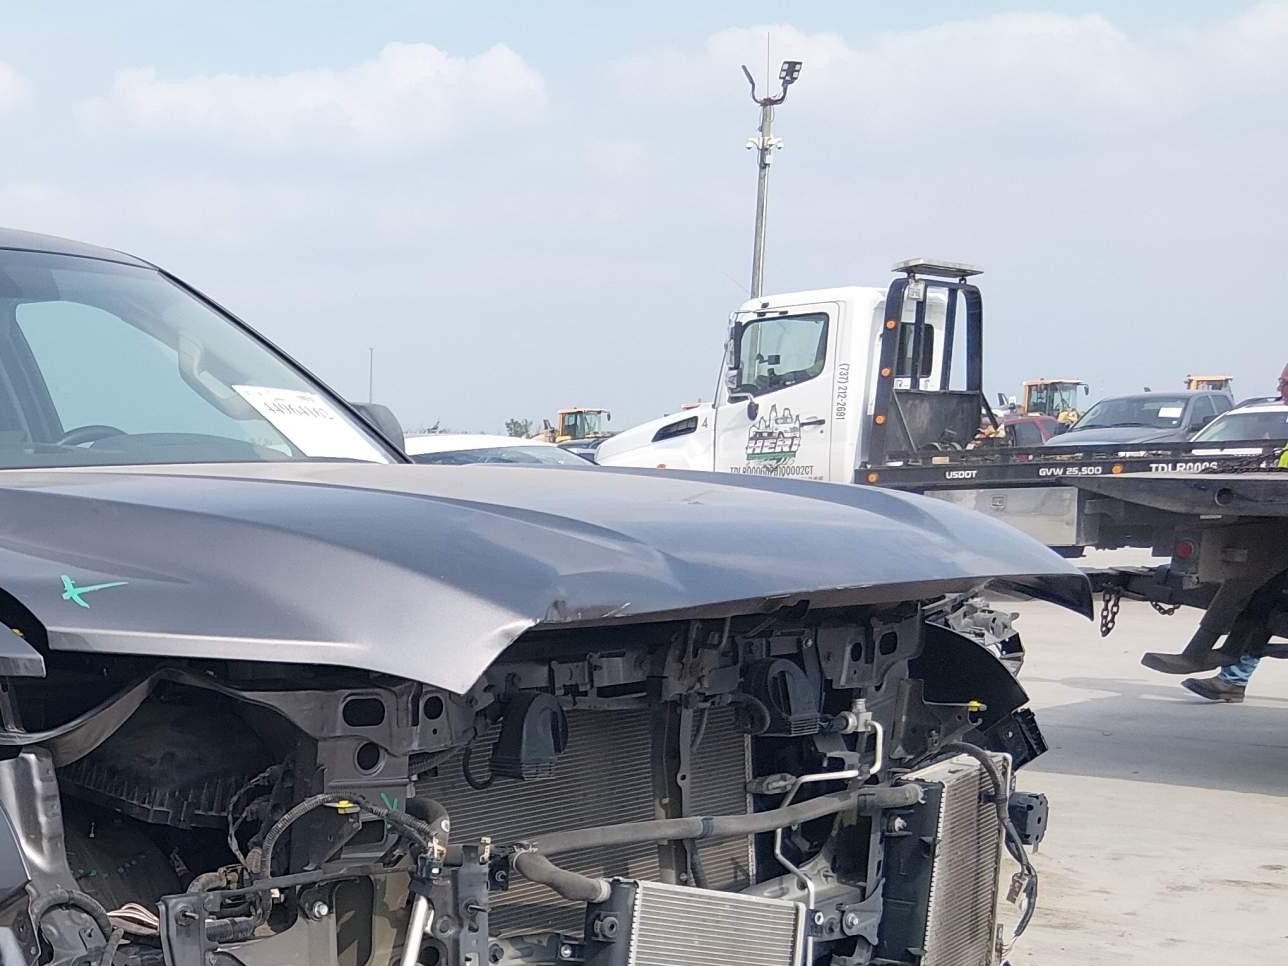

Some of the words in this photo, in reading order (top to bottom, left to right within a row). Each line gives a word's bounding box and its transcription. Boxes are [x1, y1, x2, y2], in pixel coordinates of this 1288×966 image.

[837, 363, 850, 384] (737)
[945, 470, 977, 479] USDOT
[1039, 467, 1063, 476] GVW
[1065, 466, 1102, 475] 25,500
